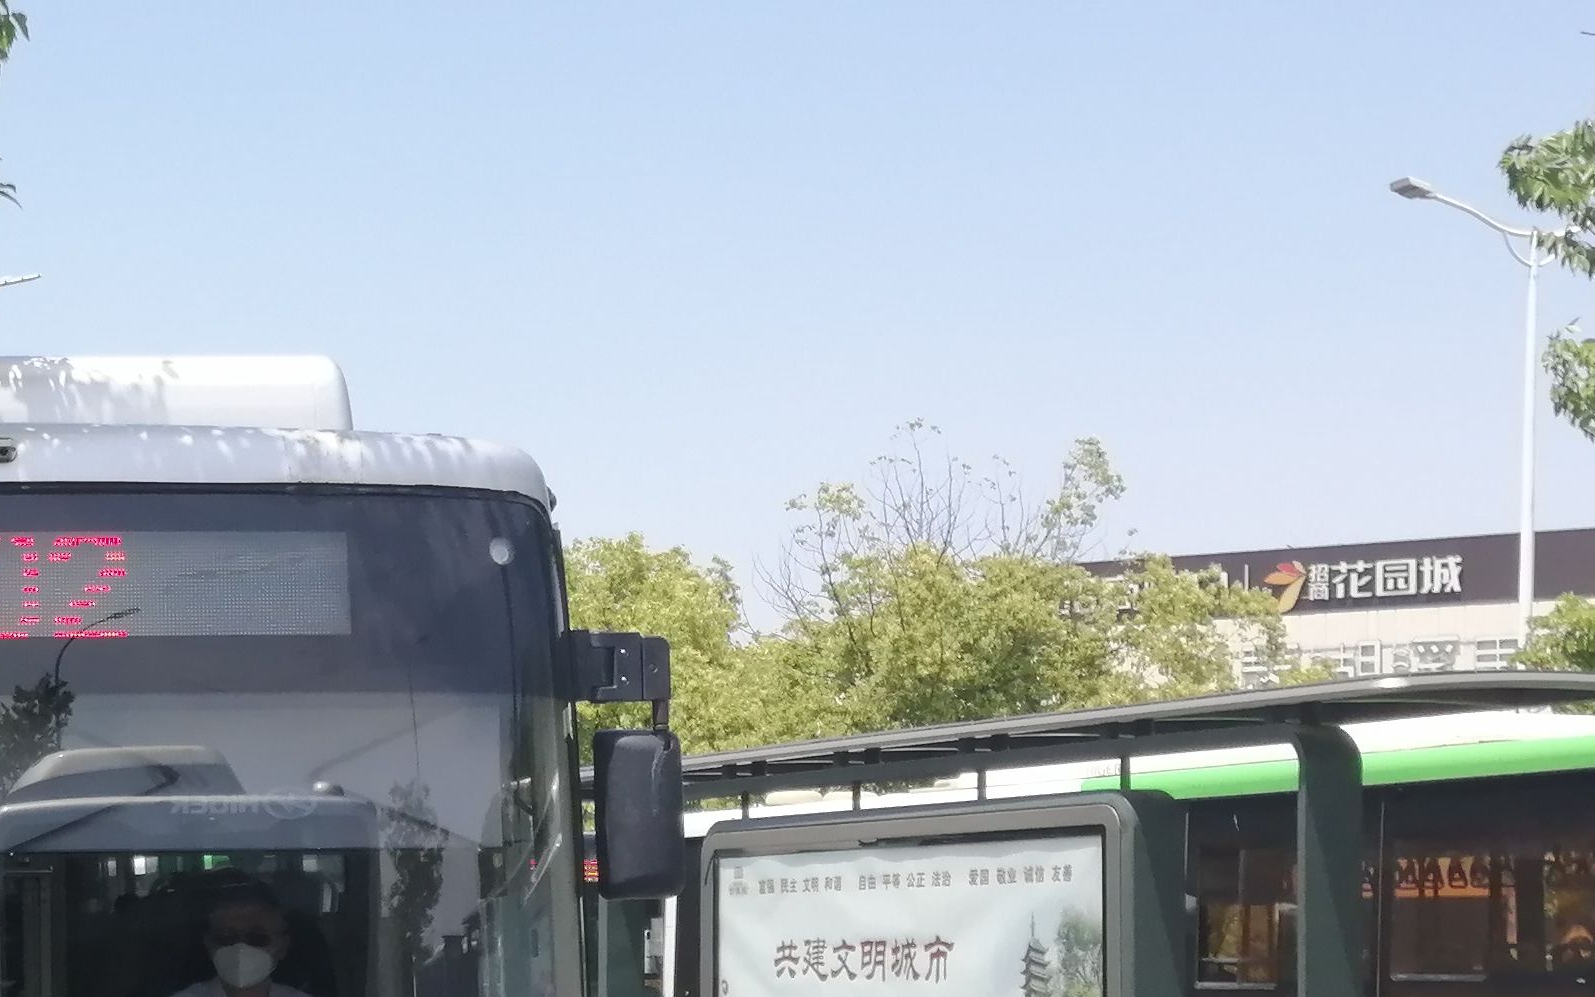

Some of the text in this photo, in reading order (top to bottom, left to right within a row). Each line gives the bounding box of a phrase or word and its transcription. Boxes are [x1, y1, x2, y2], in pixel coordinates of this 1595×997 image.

[1331, 554, 1462, 600] 花园城
[858, 875, 877, 891] 自由
[906, 871, 926, 889] 公正
[774, 935, 955, 984] 共建文明城市
